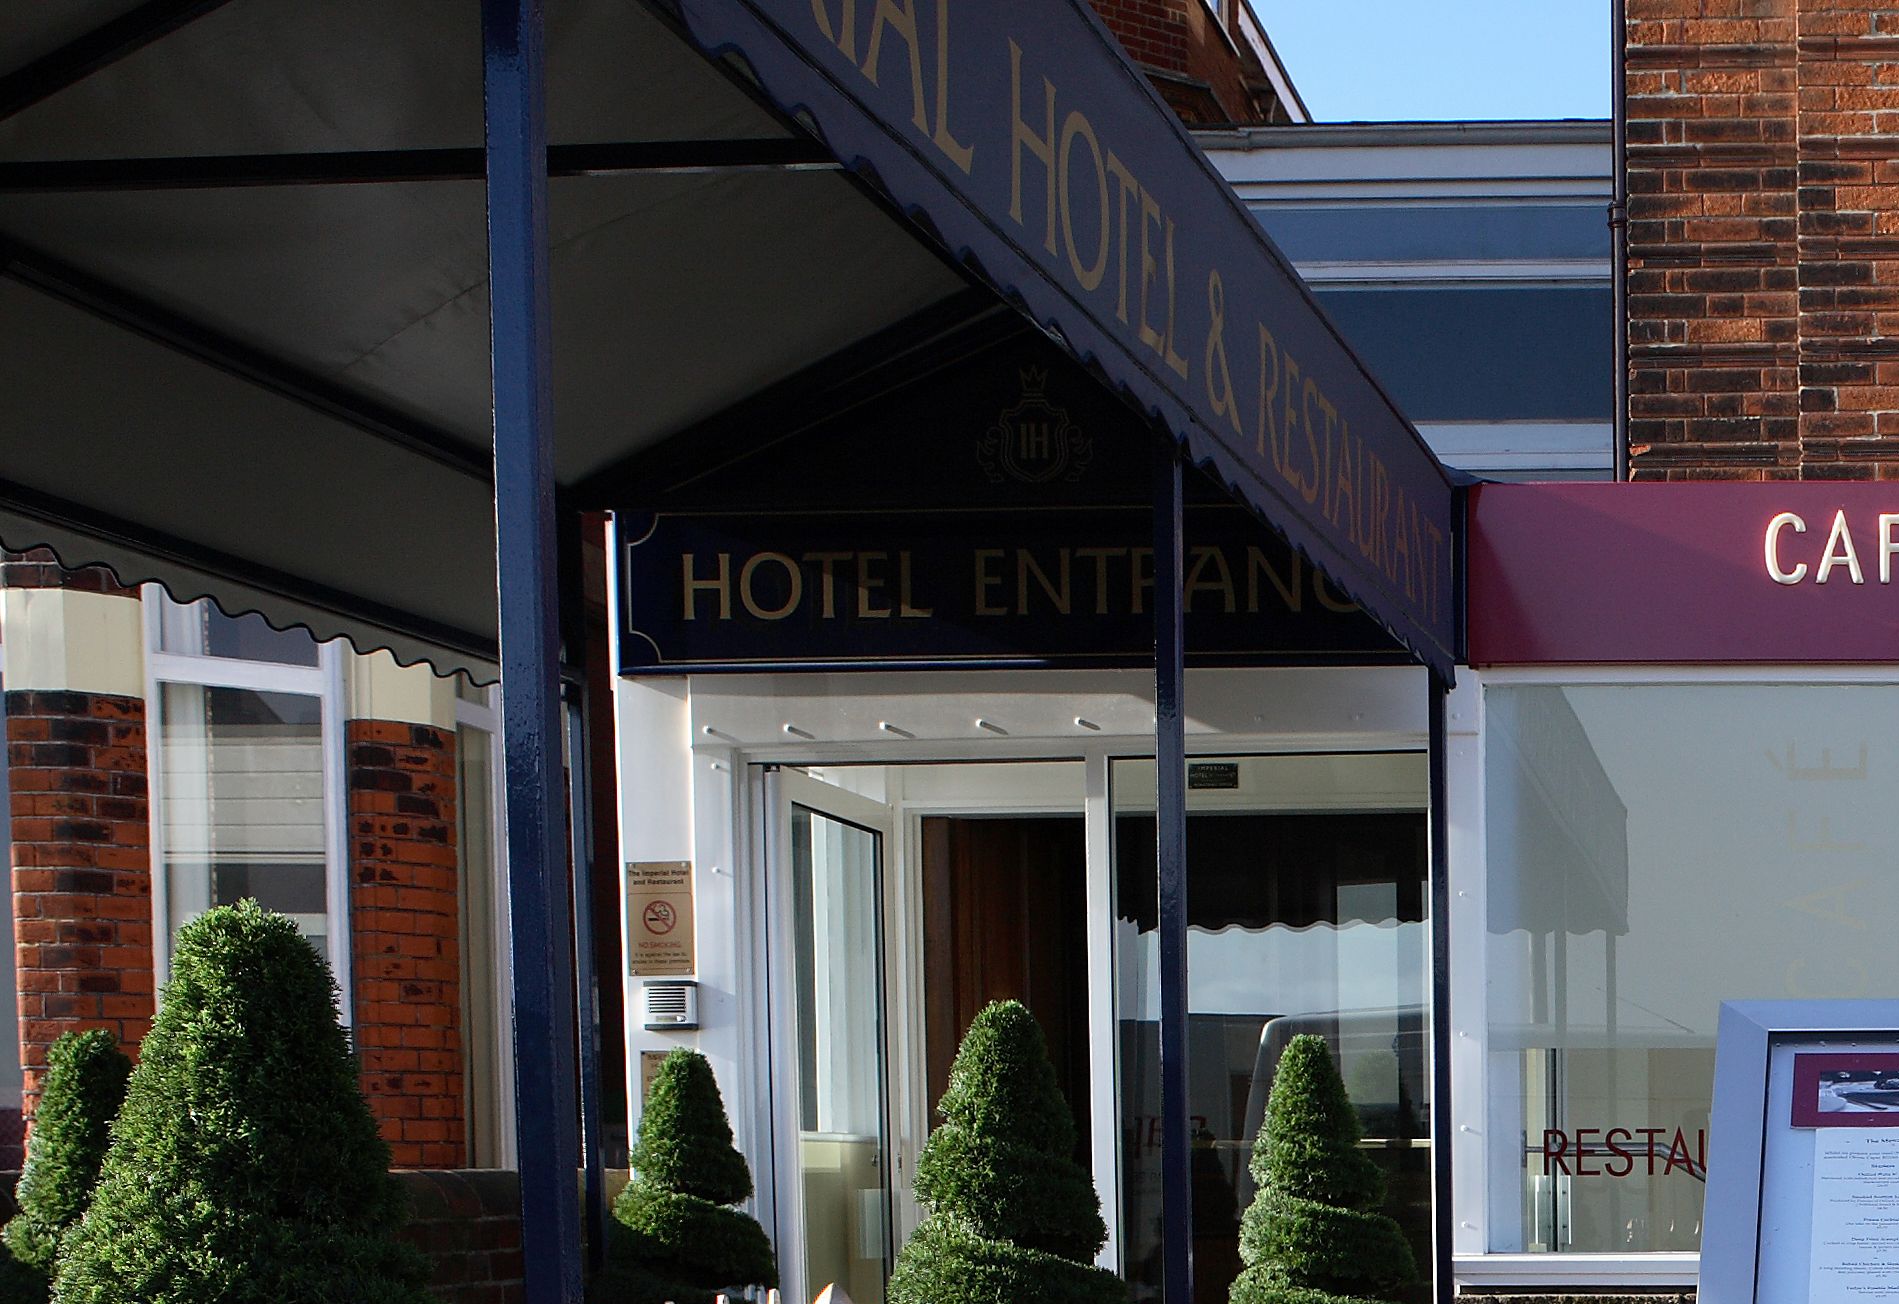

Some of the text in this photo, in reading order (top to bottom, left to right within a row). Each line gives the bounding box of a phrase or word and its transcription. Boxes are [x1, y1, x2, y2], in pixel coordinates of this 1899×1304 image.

[1008, 38, 1189, 381] HOTEL
[1205, 269, 1244, 437] &
[1256, 321, 1442, 626] RESTAURANT
[682, 550, 934, 621] HOTEL
